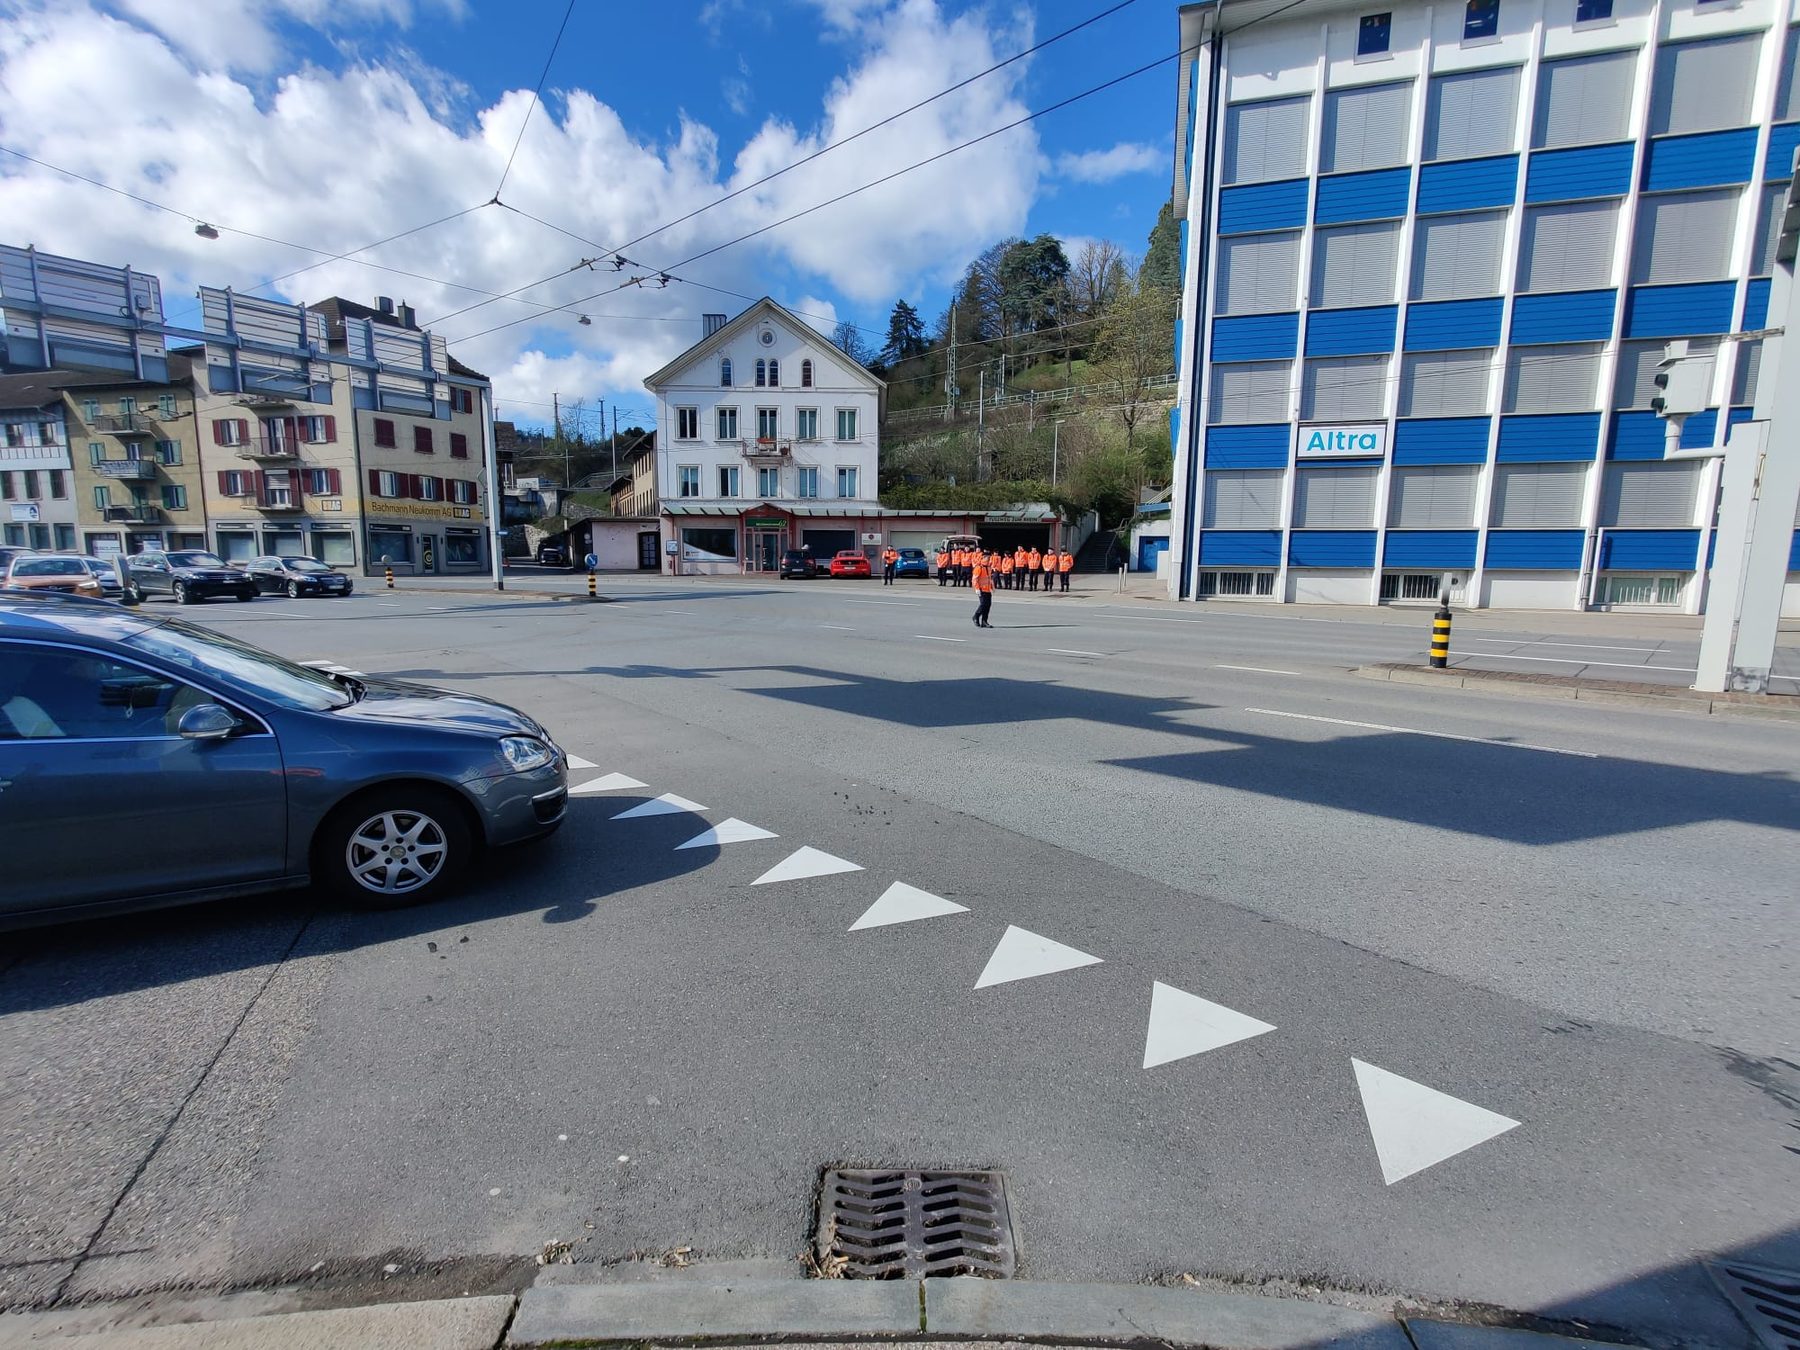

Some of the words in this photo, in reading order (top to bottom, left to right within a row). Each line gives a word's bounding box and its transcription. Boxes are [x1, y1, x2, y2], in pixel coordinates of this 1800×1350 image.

[1306, 431, 1377, 452] Altra
[371, 502, 408, 514] Bachmann
[409, 505, 441, 516] Neukomm
[442, 508, 452, 517] AG
